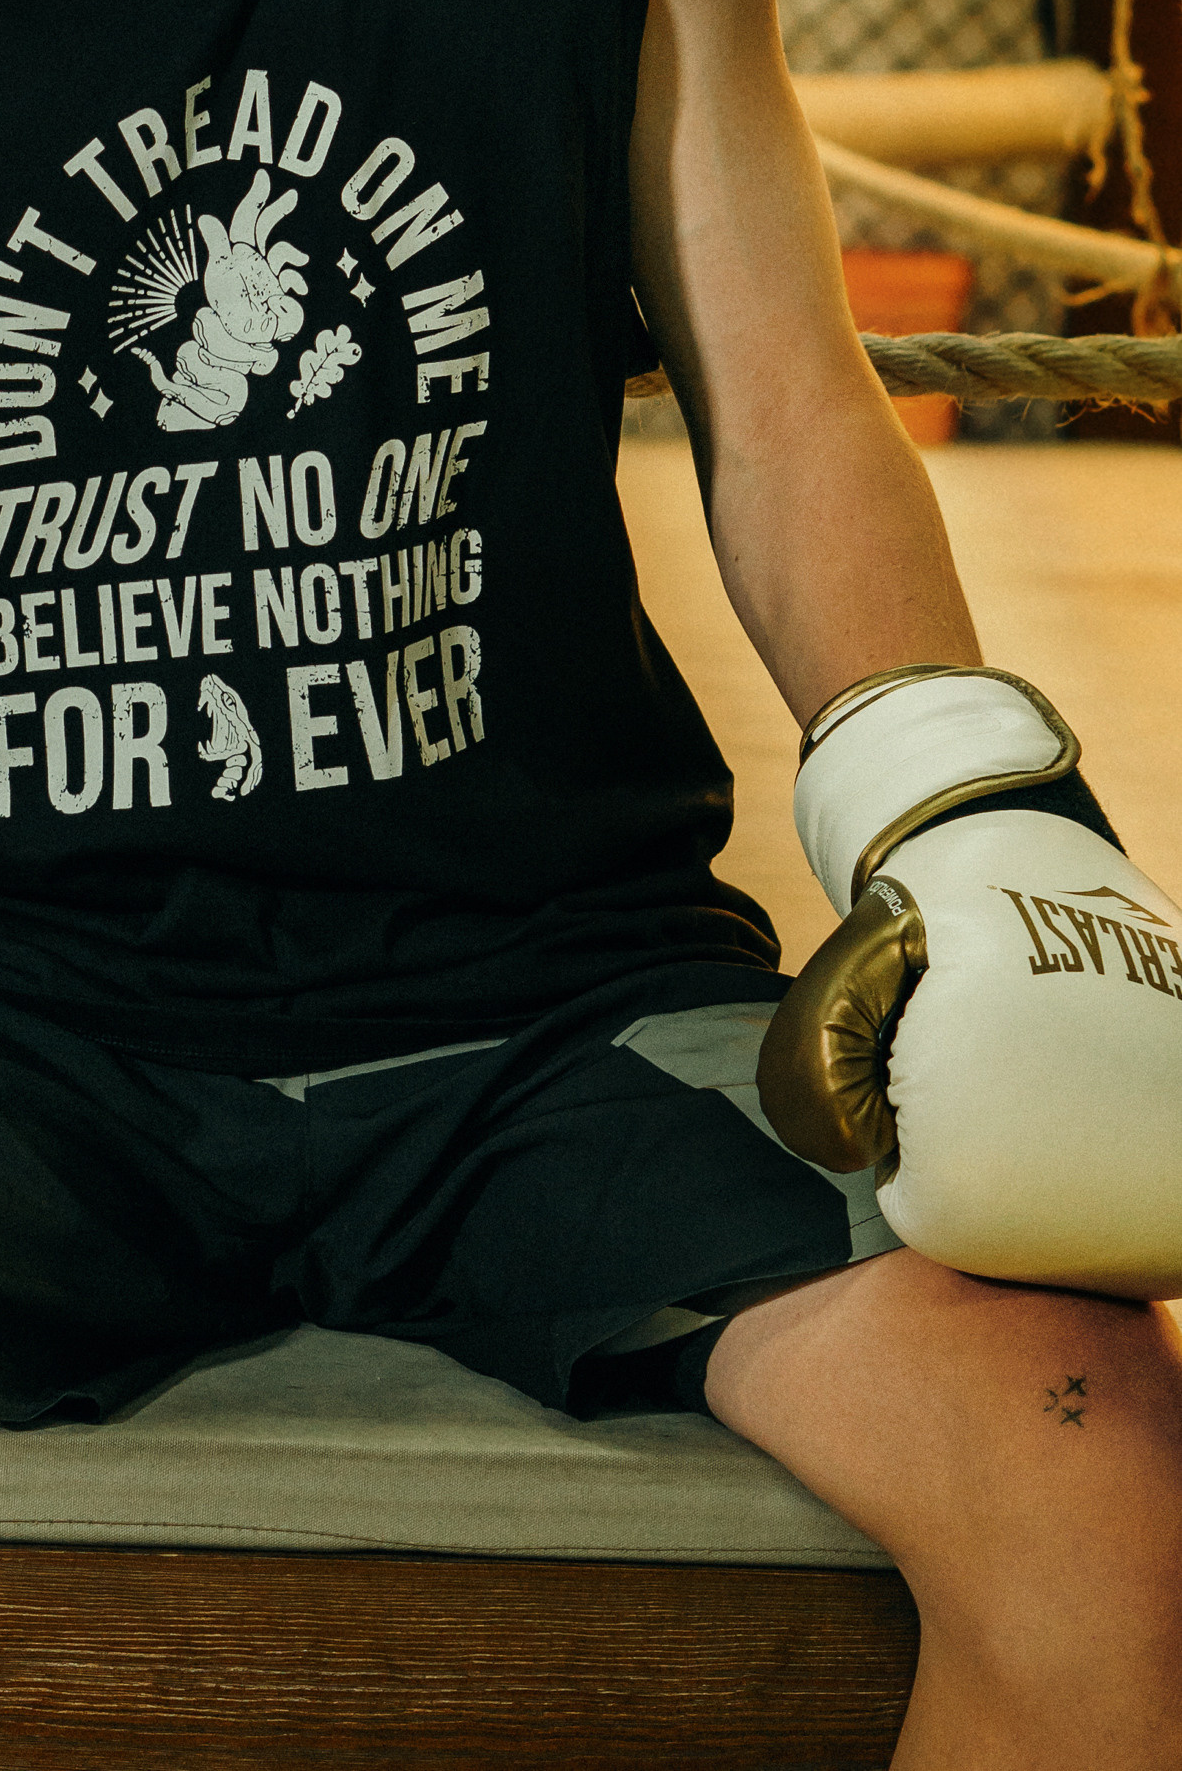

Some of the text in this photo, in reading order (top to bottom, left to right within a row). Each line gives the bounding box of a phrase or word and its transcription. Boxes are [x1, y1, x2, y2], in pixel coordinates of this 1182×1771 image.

[63, 69, 343, 223] TREAD
[341, 137, 464, 271] ON
[401, 269, 491, 404] ME
[238, 450, 338, 552] NO
[359, 419, 488, 540] ONE
[252, 527, 483, 649] NOTHING
[285, 624, 486, 792] EVER
[1000, 887, 1182, 1002] ERLAST
